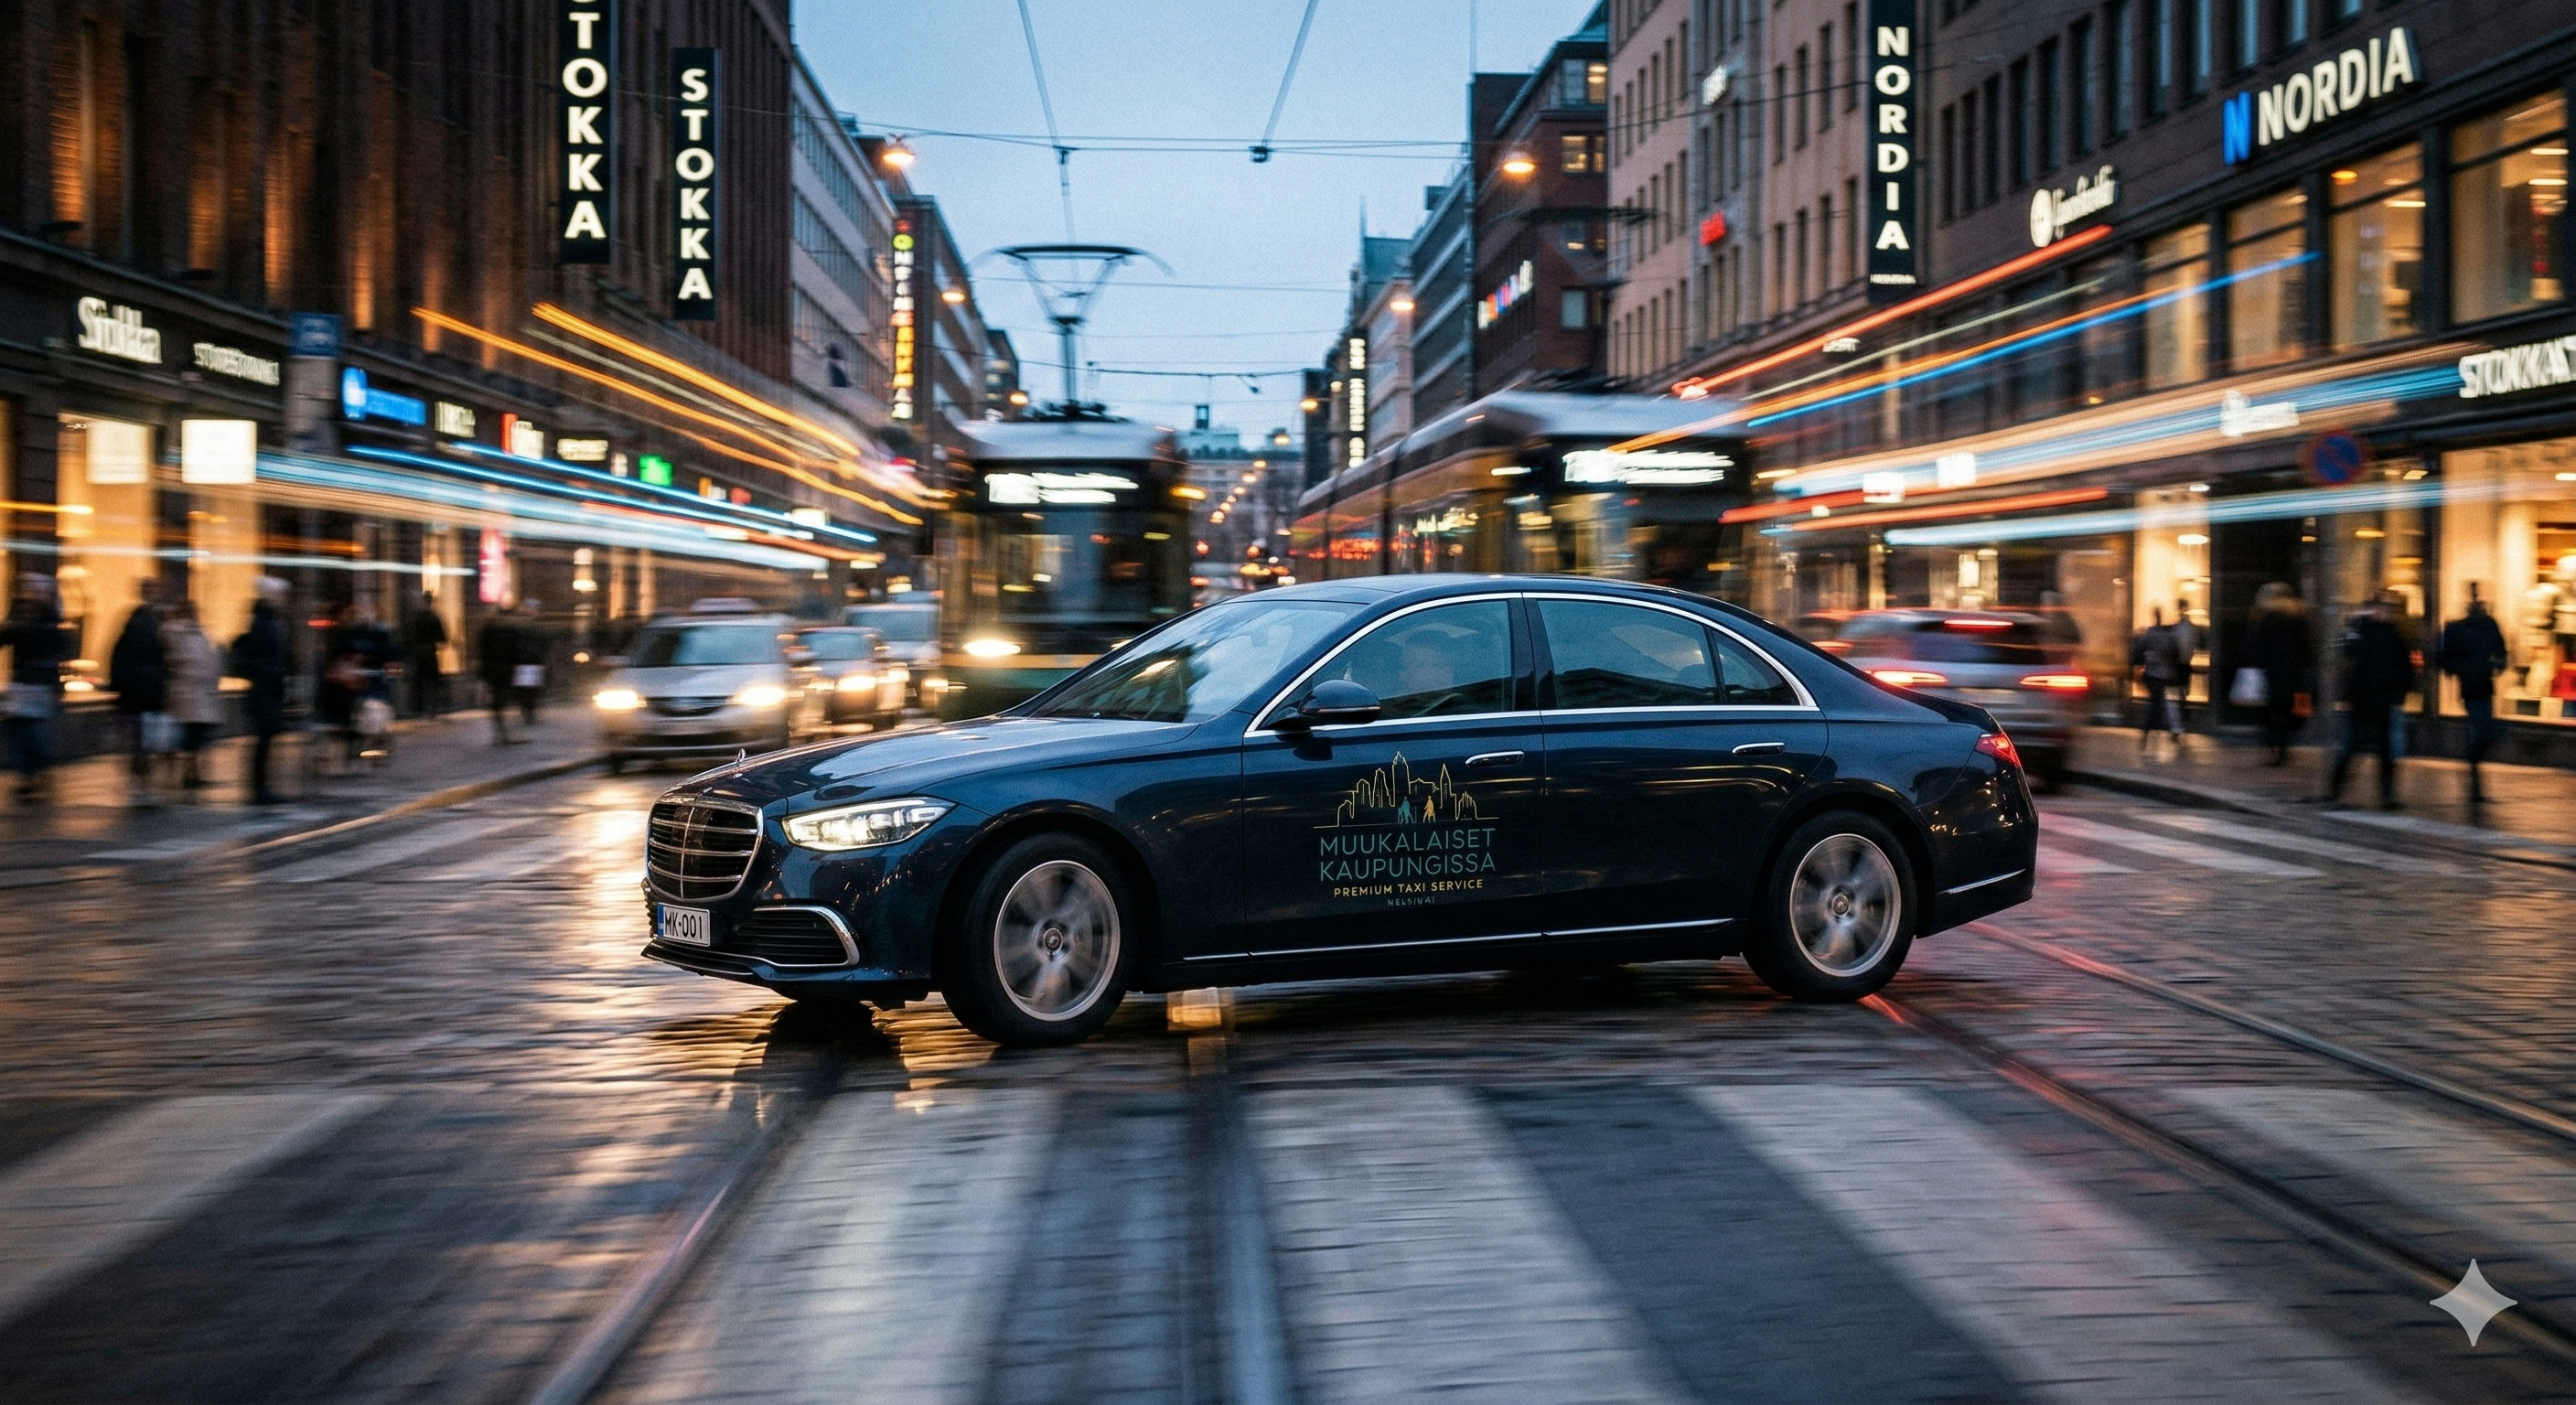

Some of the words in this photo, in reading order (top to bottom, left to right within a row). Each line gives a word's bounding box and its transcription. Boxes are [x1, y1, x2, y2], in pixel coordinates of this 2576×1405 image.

[562, 0, 608, 240] TOKKA
[1874, 26, 1911, 251] NORDIA
[2258, 27, 2415, 146] NORDIA
[675, 68, 714, 300] STOKKA
[1320, 828, 1496, 857] MUUKALAISET
[1320, 853, 1496, 882] KAUPUNGISSA
[1334, 885, 1392, 898] PREMIUM
[1398, 882, 1426, 894] TAXI
[1431, 879, 1484, 892] SERVICE
